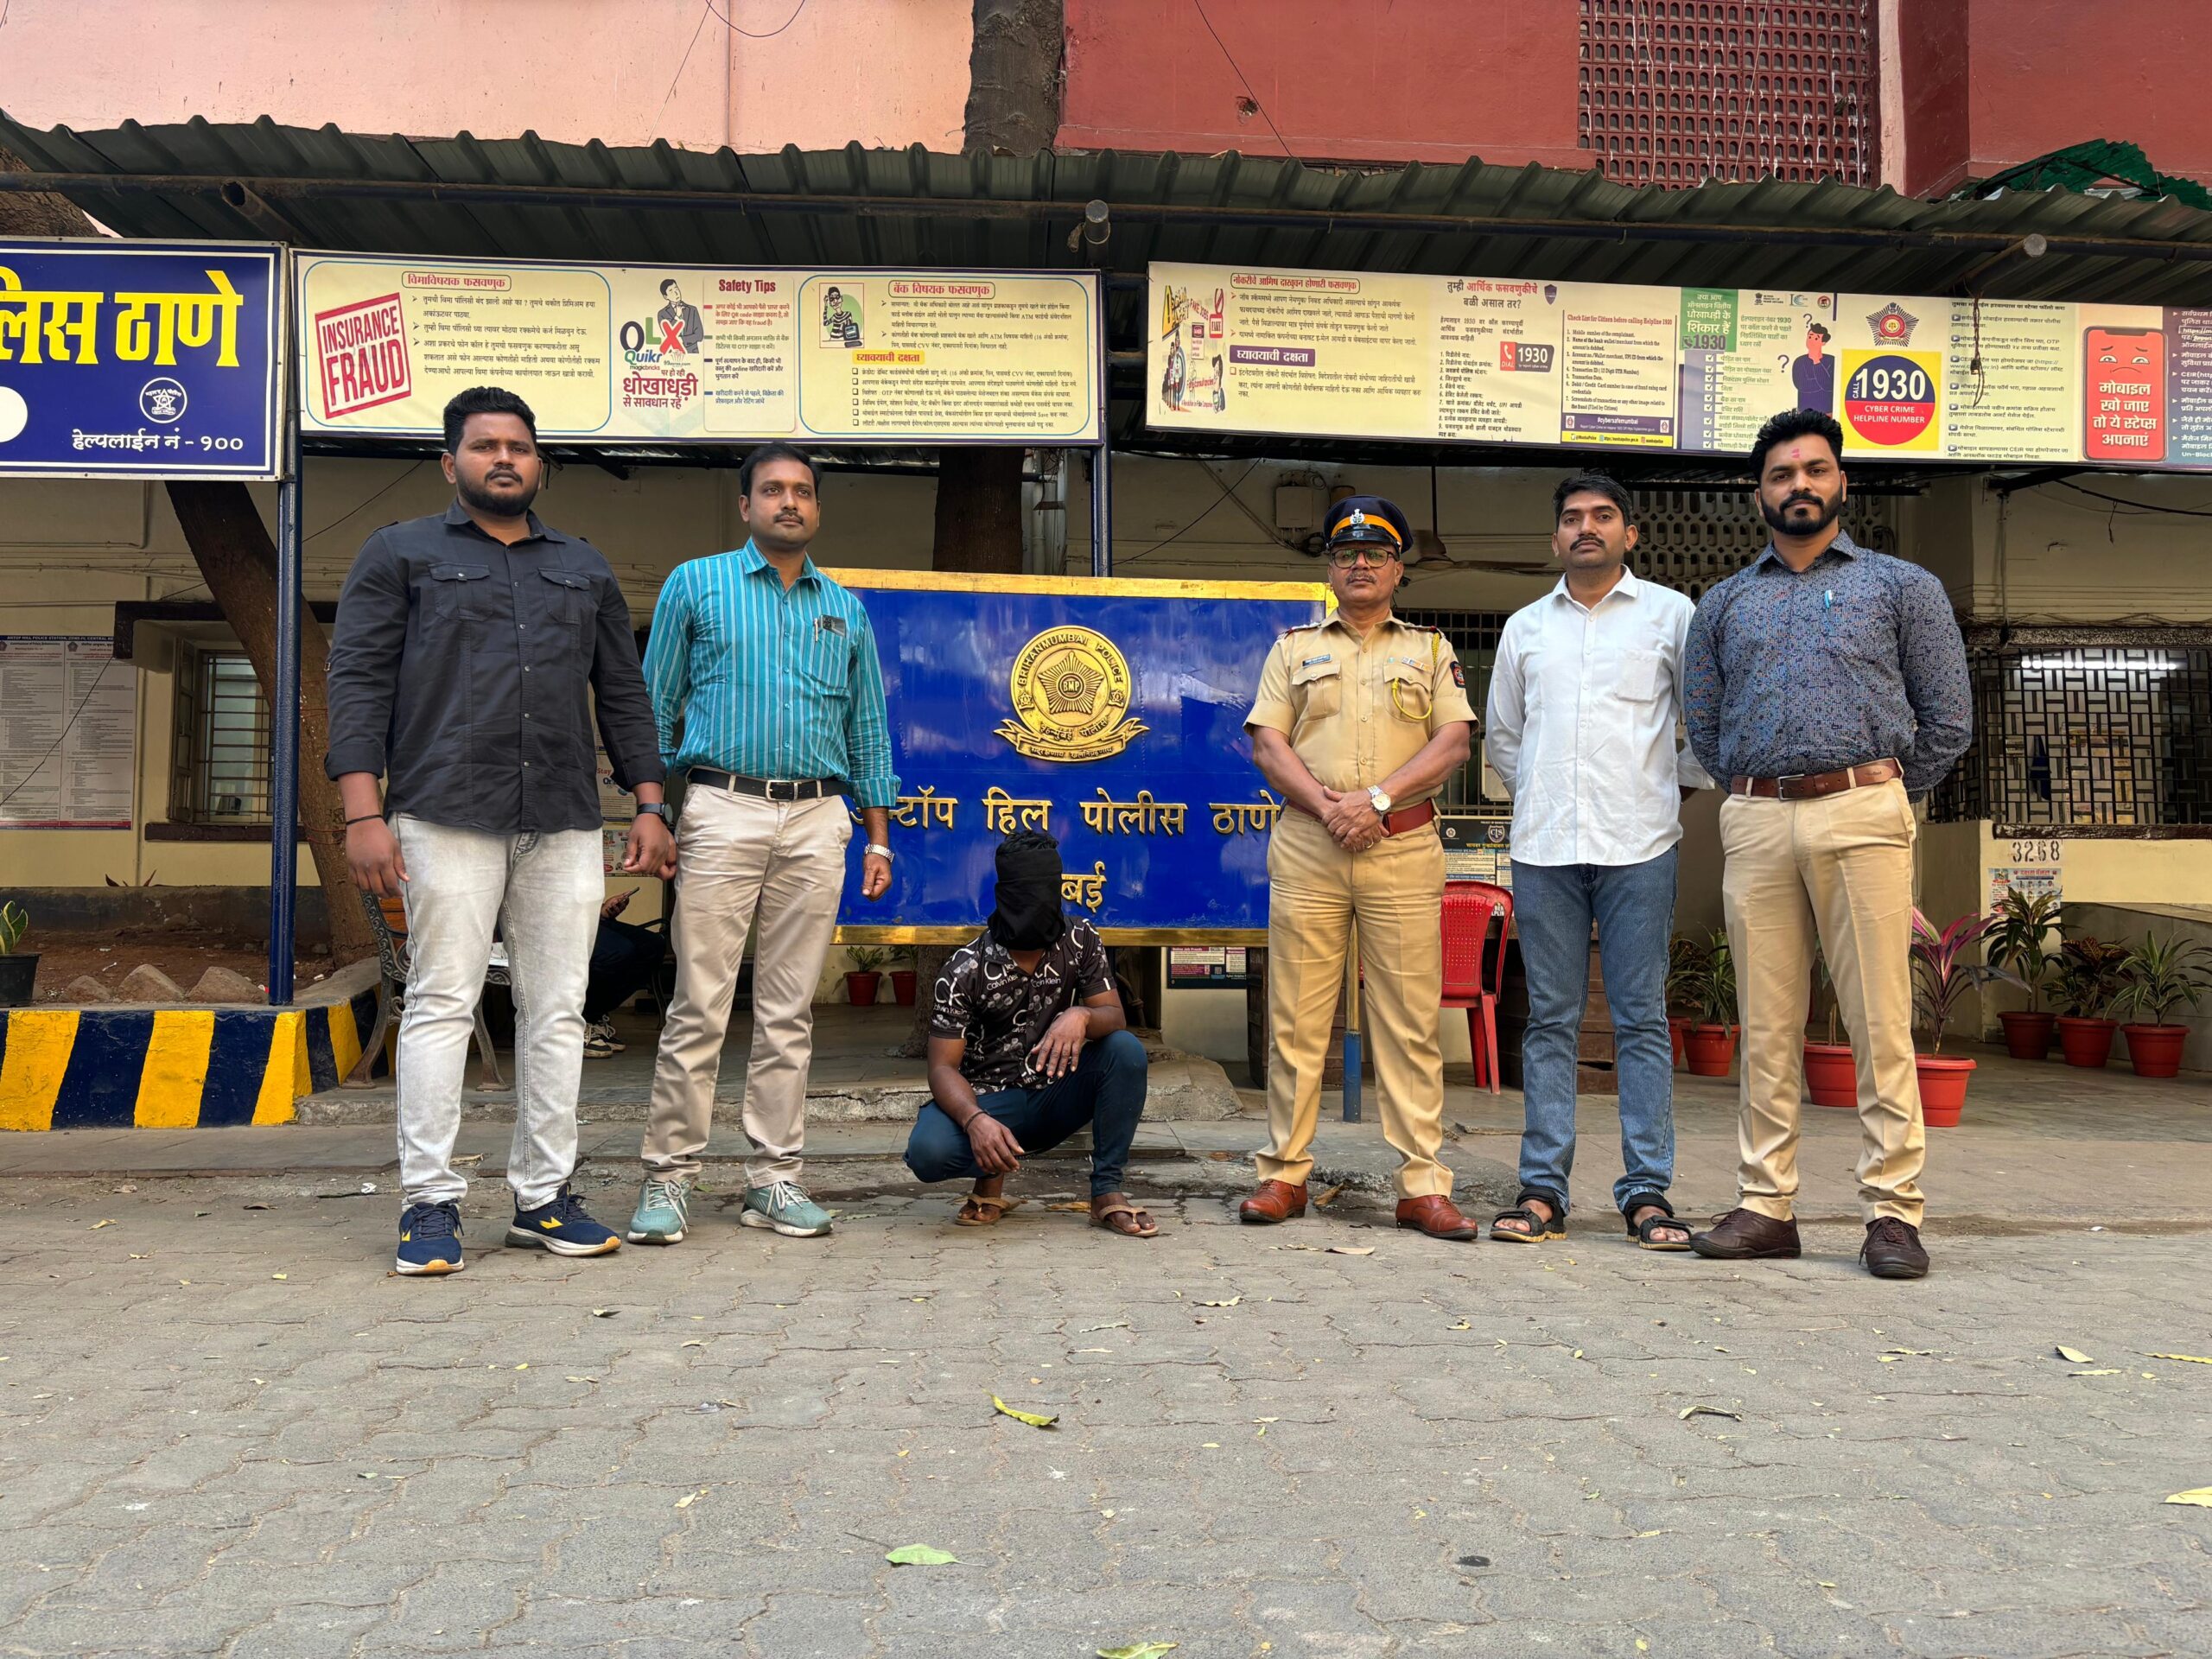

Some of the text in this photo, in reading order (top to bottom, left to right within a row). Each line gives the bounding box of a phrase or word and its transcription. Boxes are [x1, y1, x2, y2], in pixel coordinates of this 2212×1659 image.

[408, 274, 505, 289] विमाविषयक फसवणुक
[719, 279, 776, 294] Safety Tips
[1233, 275, 1256, 285] नोकरीचे
[1447, 279, 1538, 296] तुम्ही आर्थिक फसवणुकीचे
[912, 283, 944, 295] विषयक
[948, 284, 989, 297] फसवणुक
[441, 295, 453, 303] विमा
[454, 296, 474, 304] पॉलिसी
[1464, 296, 1522, 308] बळी असाल तर?
[114, 270, 244, 366] ठाणे
[1722, 310, 1731, 320] के
[322, 305, 399, 354] INSURANCE
[438, 322, 450, 332] विमा
[453, 323, 471, 332] पॉलिसी
[1687, 320, 1730, 334] शिकार हैं
[620, 317, 686, 356] OLX
[1694, 334, 1726, 350] 1930
[625, 349, 662, 365] Quikr
[856, 352, 894, 362] घ्यावयाची
[1237, 349, 1308, 363] घ्यावयाची दक्षता
[1517, 346, 1548, 363] 1930
[327, 340, 404, 406] FRAUD
[623, 372, 698, 400] धोखाधड़ी
[1856, 368, 1926, 401] 1930
[2099, 380, 2152, 396] मोबाइल
[623, 394, 682, 409] से सावधान रहें
[1865, 404, 1889, 413] CYBER
[2100, 397, 2150, 413] खो जाए
[1891, 415, 1925, 423] NUMBER
[2093, 414, 2158, 429] तो ये स्टेप्स
[73, 428, 161, 451] हेल्पलाईन
[164, 427, 181, 449] नं
[200, 435, 244, 451] १००
[2101, 432, 2149, 447] अपनाएं
[1017, 633, 1123, 687] BRIHANMUMBAI POLICE
[1063, 681, 1080, 692] BMP
[982, 786, 1053, 835] हिल
[1078, 787, 1188, 836] पोलीस
[1208, 789, 1281, 836] ठाणे
[2012, 840, 2060, 862] 3268
[1061, 861, 1107, 913] बई
